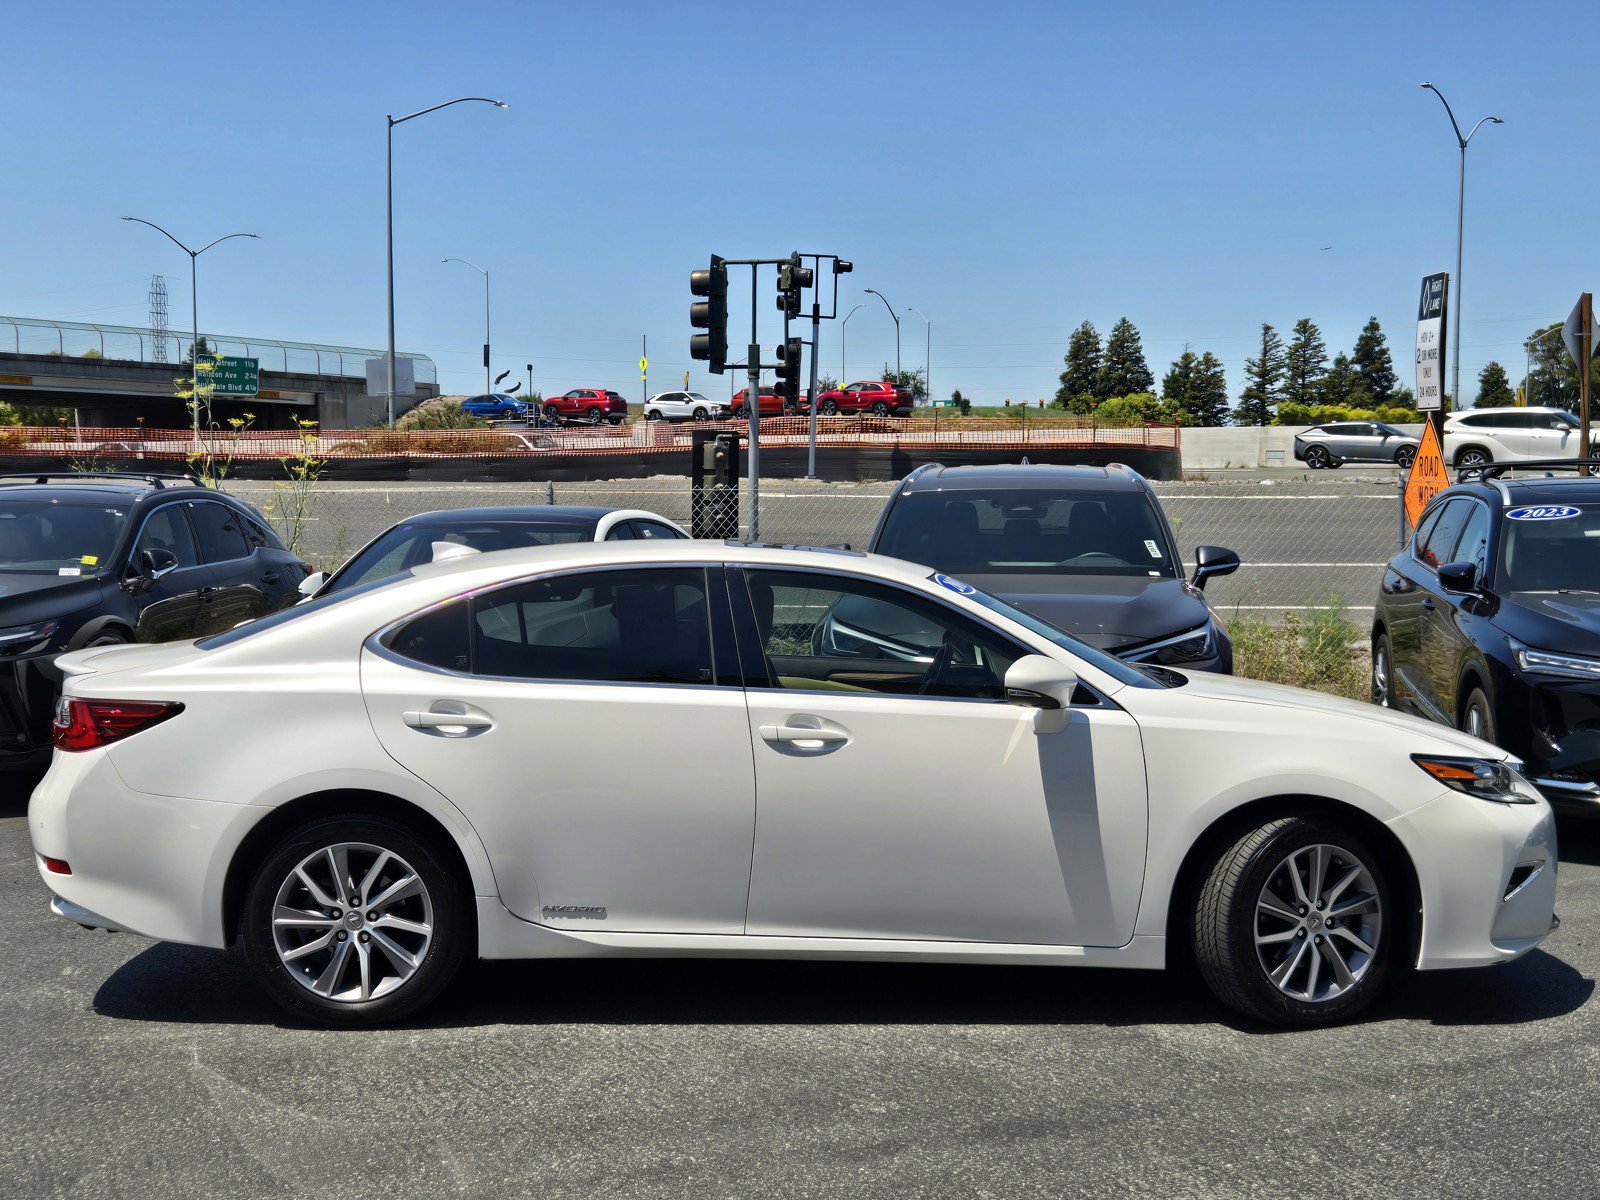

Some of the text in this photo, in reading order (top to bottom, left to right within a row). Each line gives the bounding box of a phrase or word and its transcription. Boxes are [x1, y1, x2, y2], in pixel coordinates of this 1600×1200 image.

[1416, 348, 1421, 364] 2
[1427, 348, 1438, 360] MORE
[225, 371, 237, 379] Ave
[1425, 385, 1438, 397] HOURS
[1418, 456, 1439, 477] ROAD
[1418, 486, 1438, 506] WOR
[1520, 507, 1570, 519] 2023
